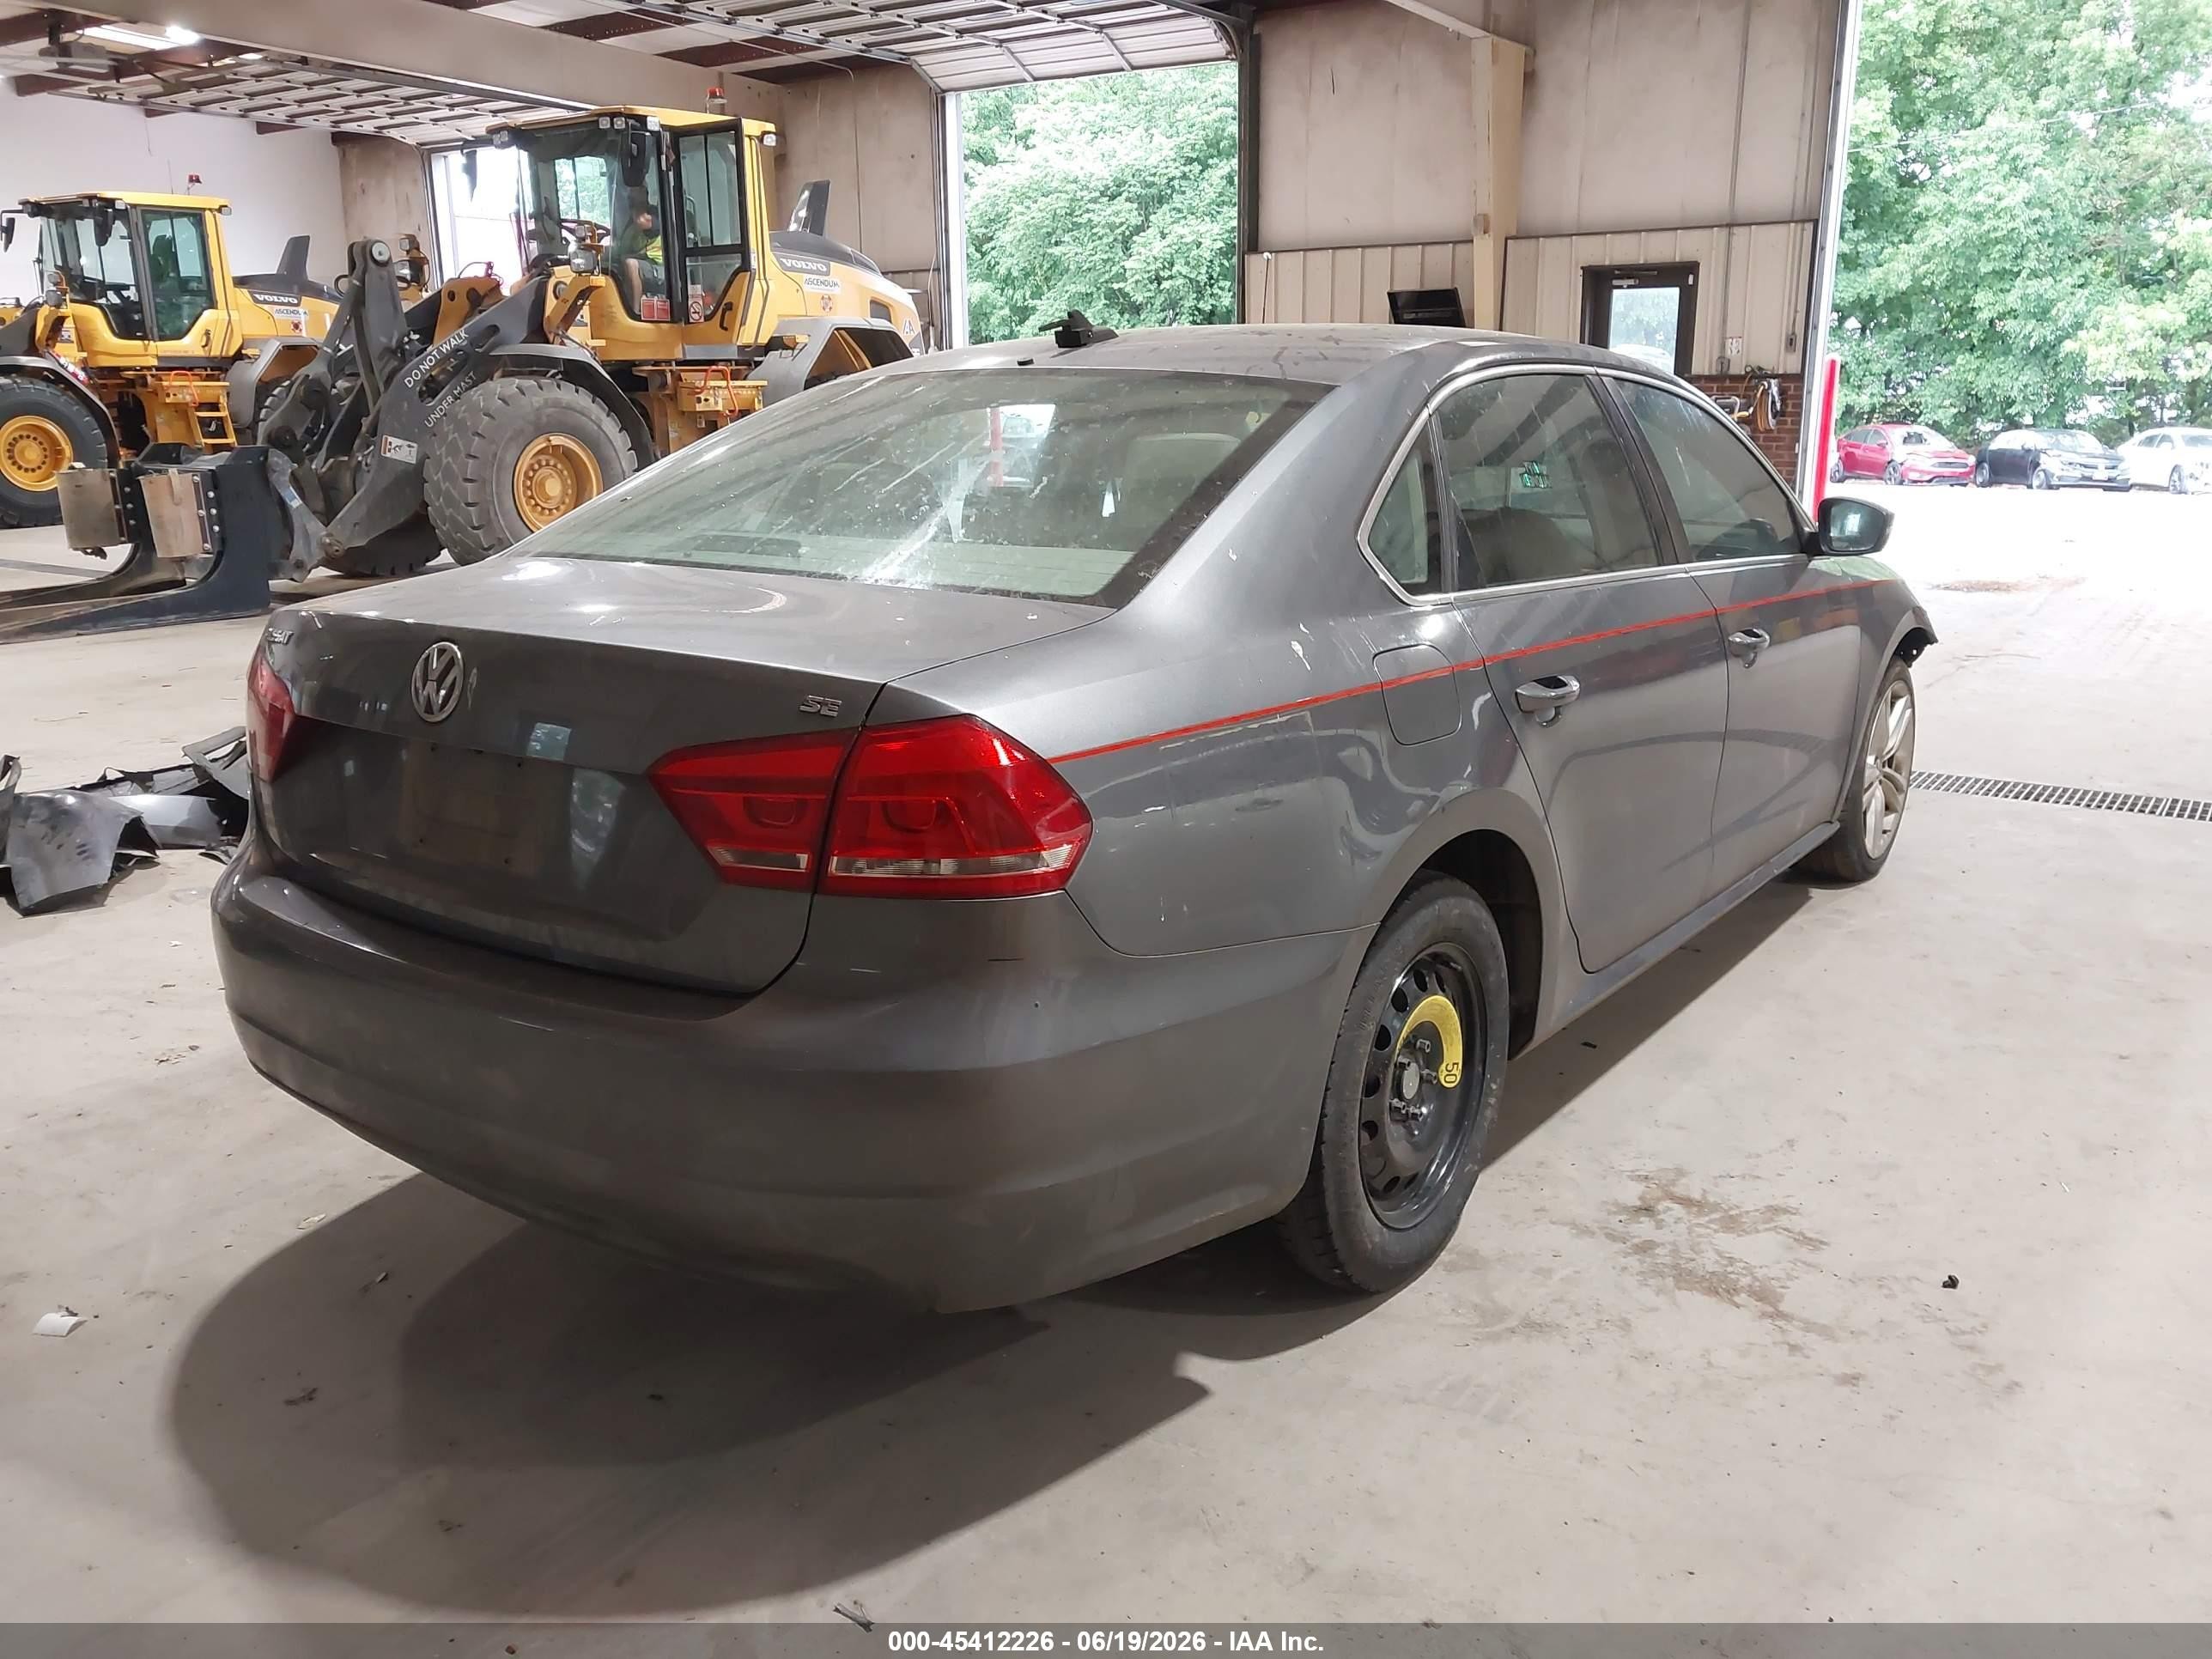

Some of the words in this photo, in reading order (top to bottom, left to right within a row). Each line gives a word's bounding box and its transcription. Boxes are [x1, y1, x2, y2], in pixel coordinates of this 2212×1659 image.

[780, 258, 828, 272] VOLVO
[804, 277, 840, 289] ASCENDUM
[252, 294, 298, 304] VOLVO
[404, 368, 422, 388] DO
[418, 350, 442, 374] NOT
[440, 329, 470, 354] WALK
[424, 394, 456, 428] UNDER
[453, 370, 477, 398] MAST
[799, 695, 842, 717] SE
[1443, 1061, 1459, 1084] 50
